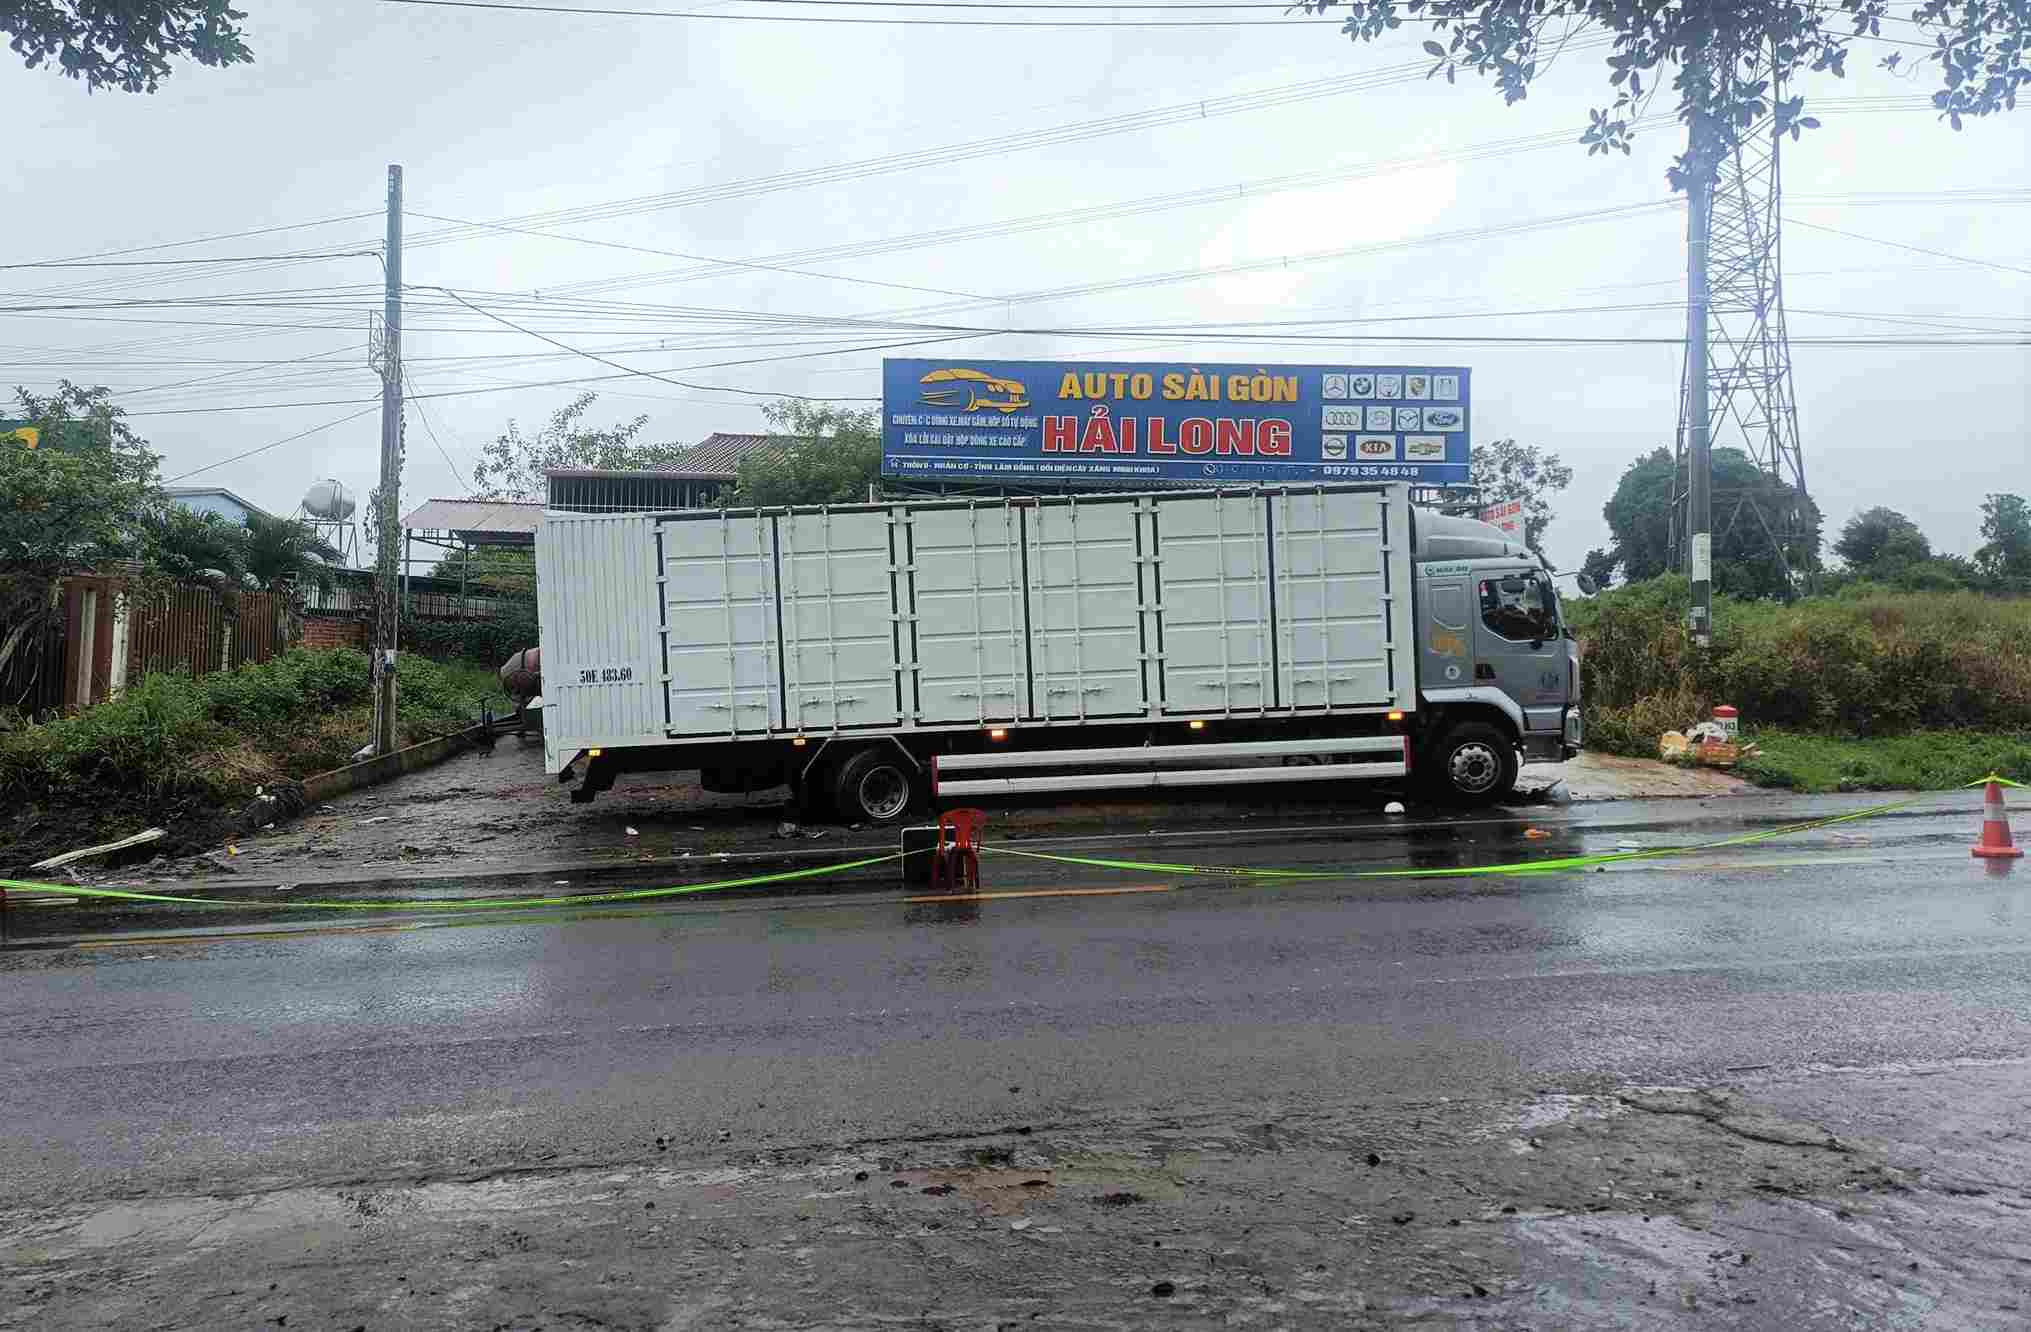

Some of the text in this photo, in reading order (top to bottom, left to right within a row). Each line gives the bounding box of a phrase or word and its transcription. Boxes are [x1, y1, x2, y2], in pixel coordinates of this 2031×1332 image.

[1058, 367, 1298, 402] AUTO SÀI GÒN
[1041, 405, 1293, 456] HẢI LONG
[1364, 442, 1388, 453] KIA
